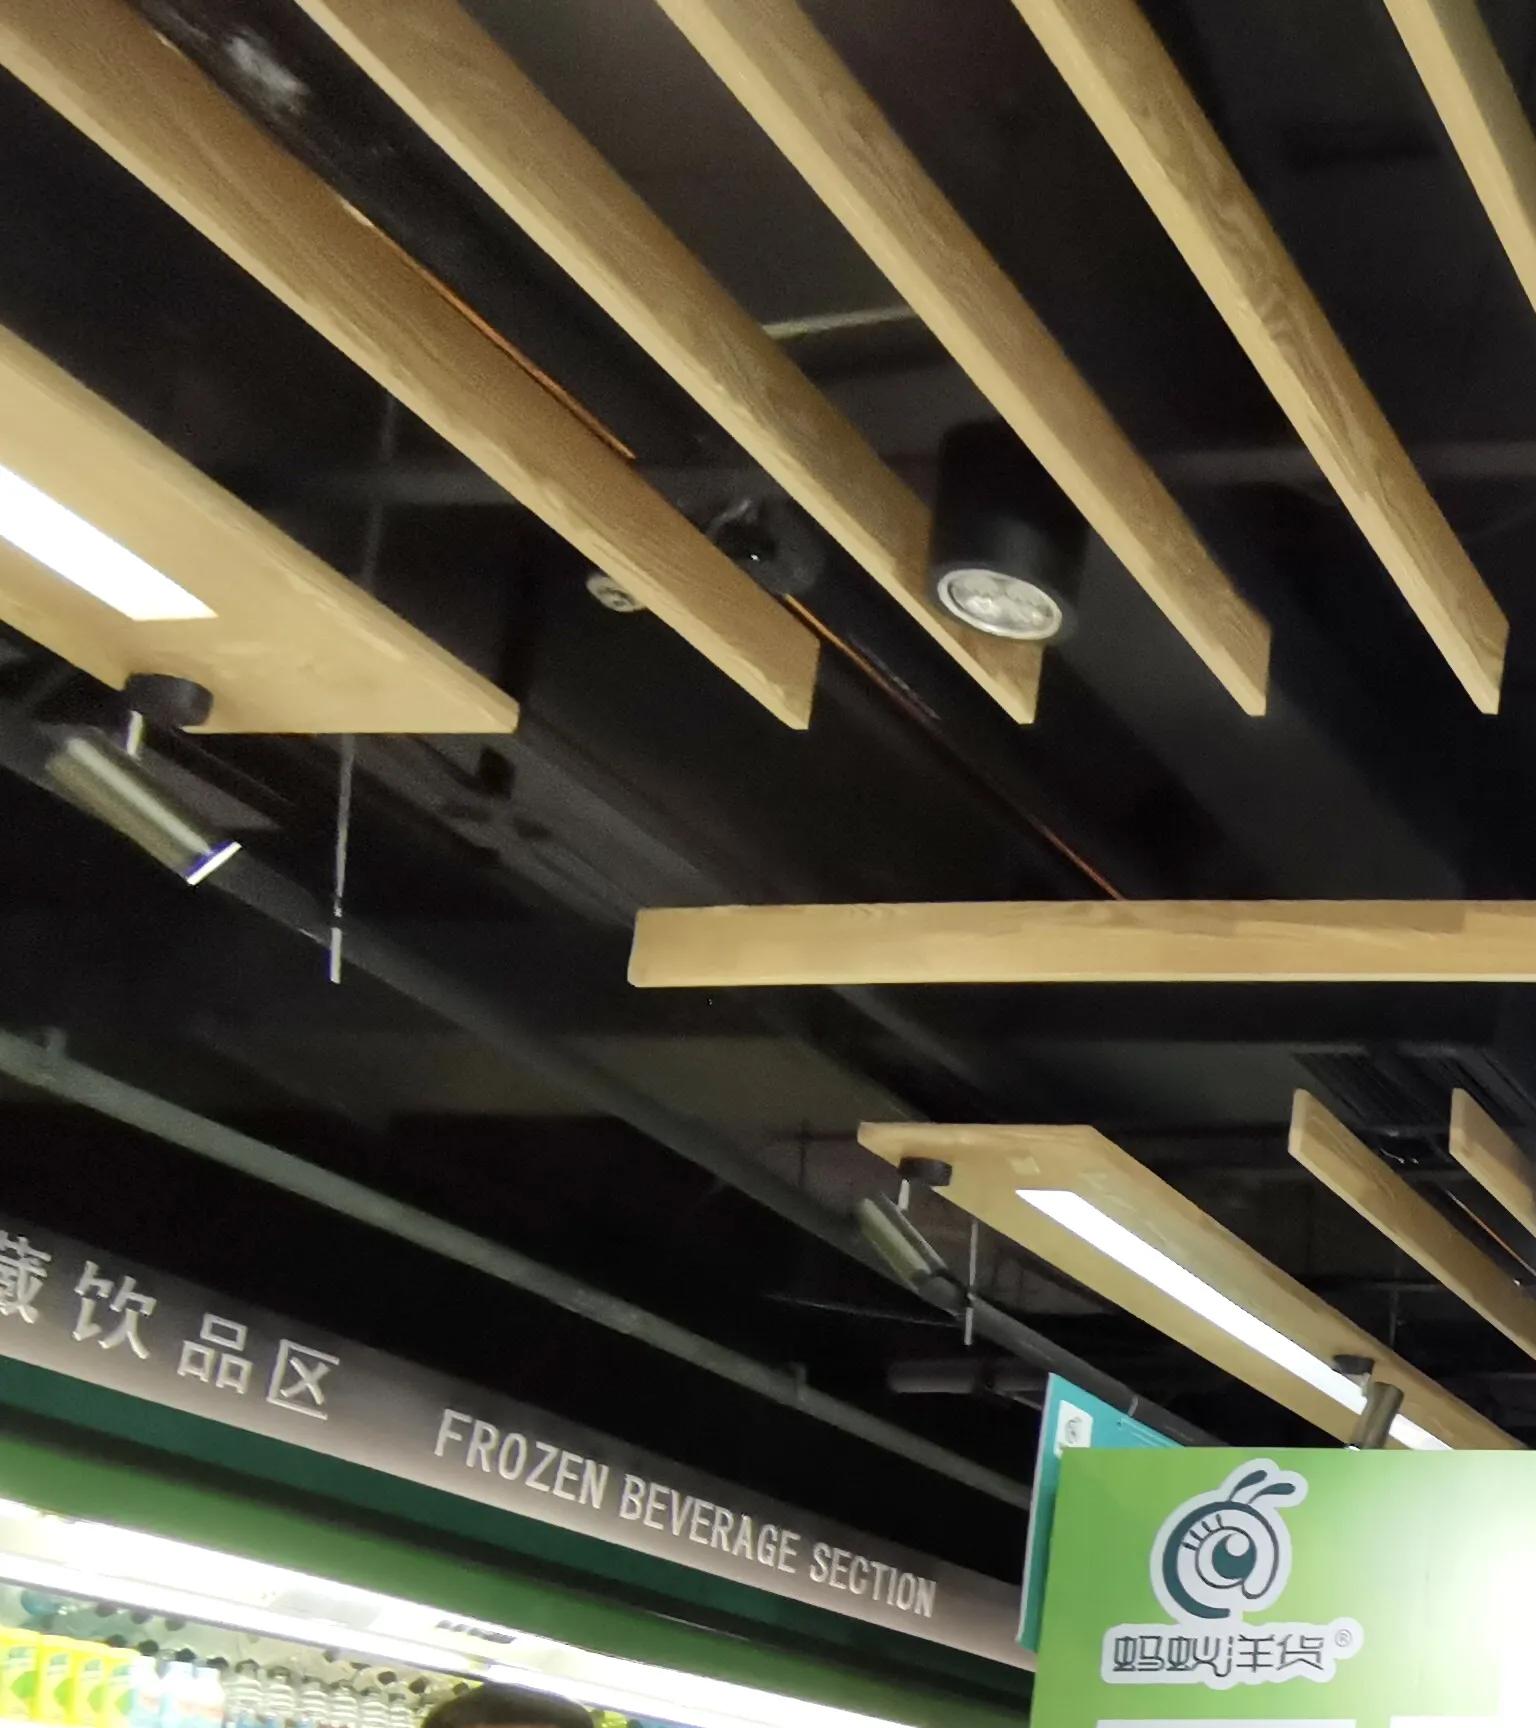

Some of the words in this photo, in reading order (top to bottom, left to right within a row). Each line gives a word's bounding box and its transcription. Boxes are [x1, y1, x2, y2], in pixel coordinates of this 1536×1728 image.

[433, 1408, 609, 1510] FROZEN
[618, 1472, 802, 1577] BEVERAGE
[810, 1541, 938, 1619] SECTION
[1112, 1632, 1325, 1678] 蚂蚁洋货
